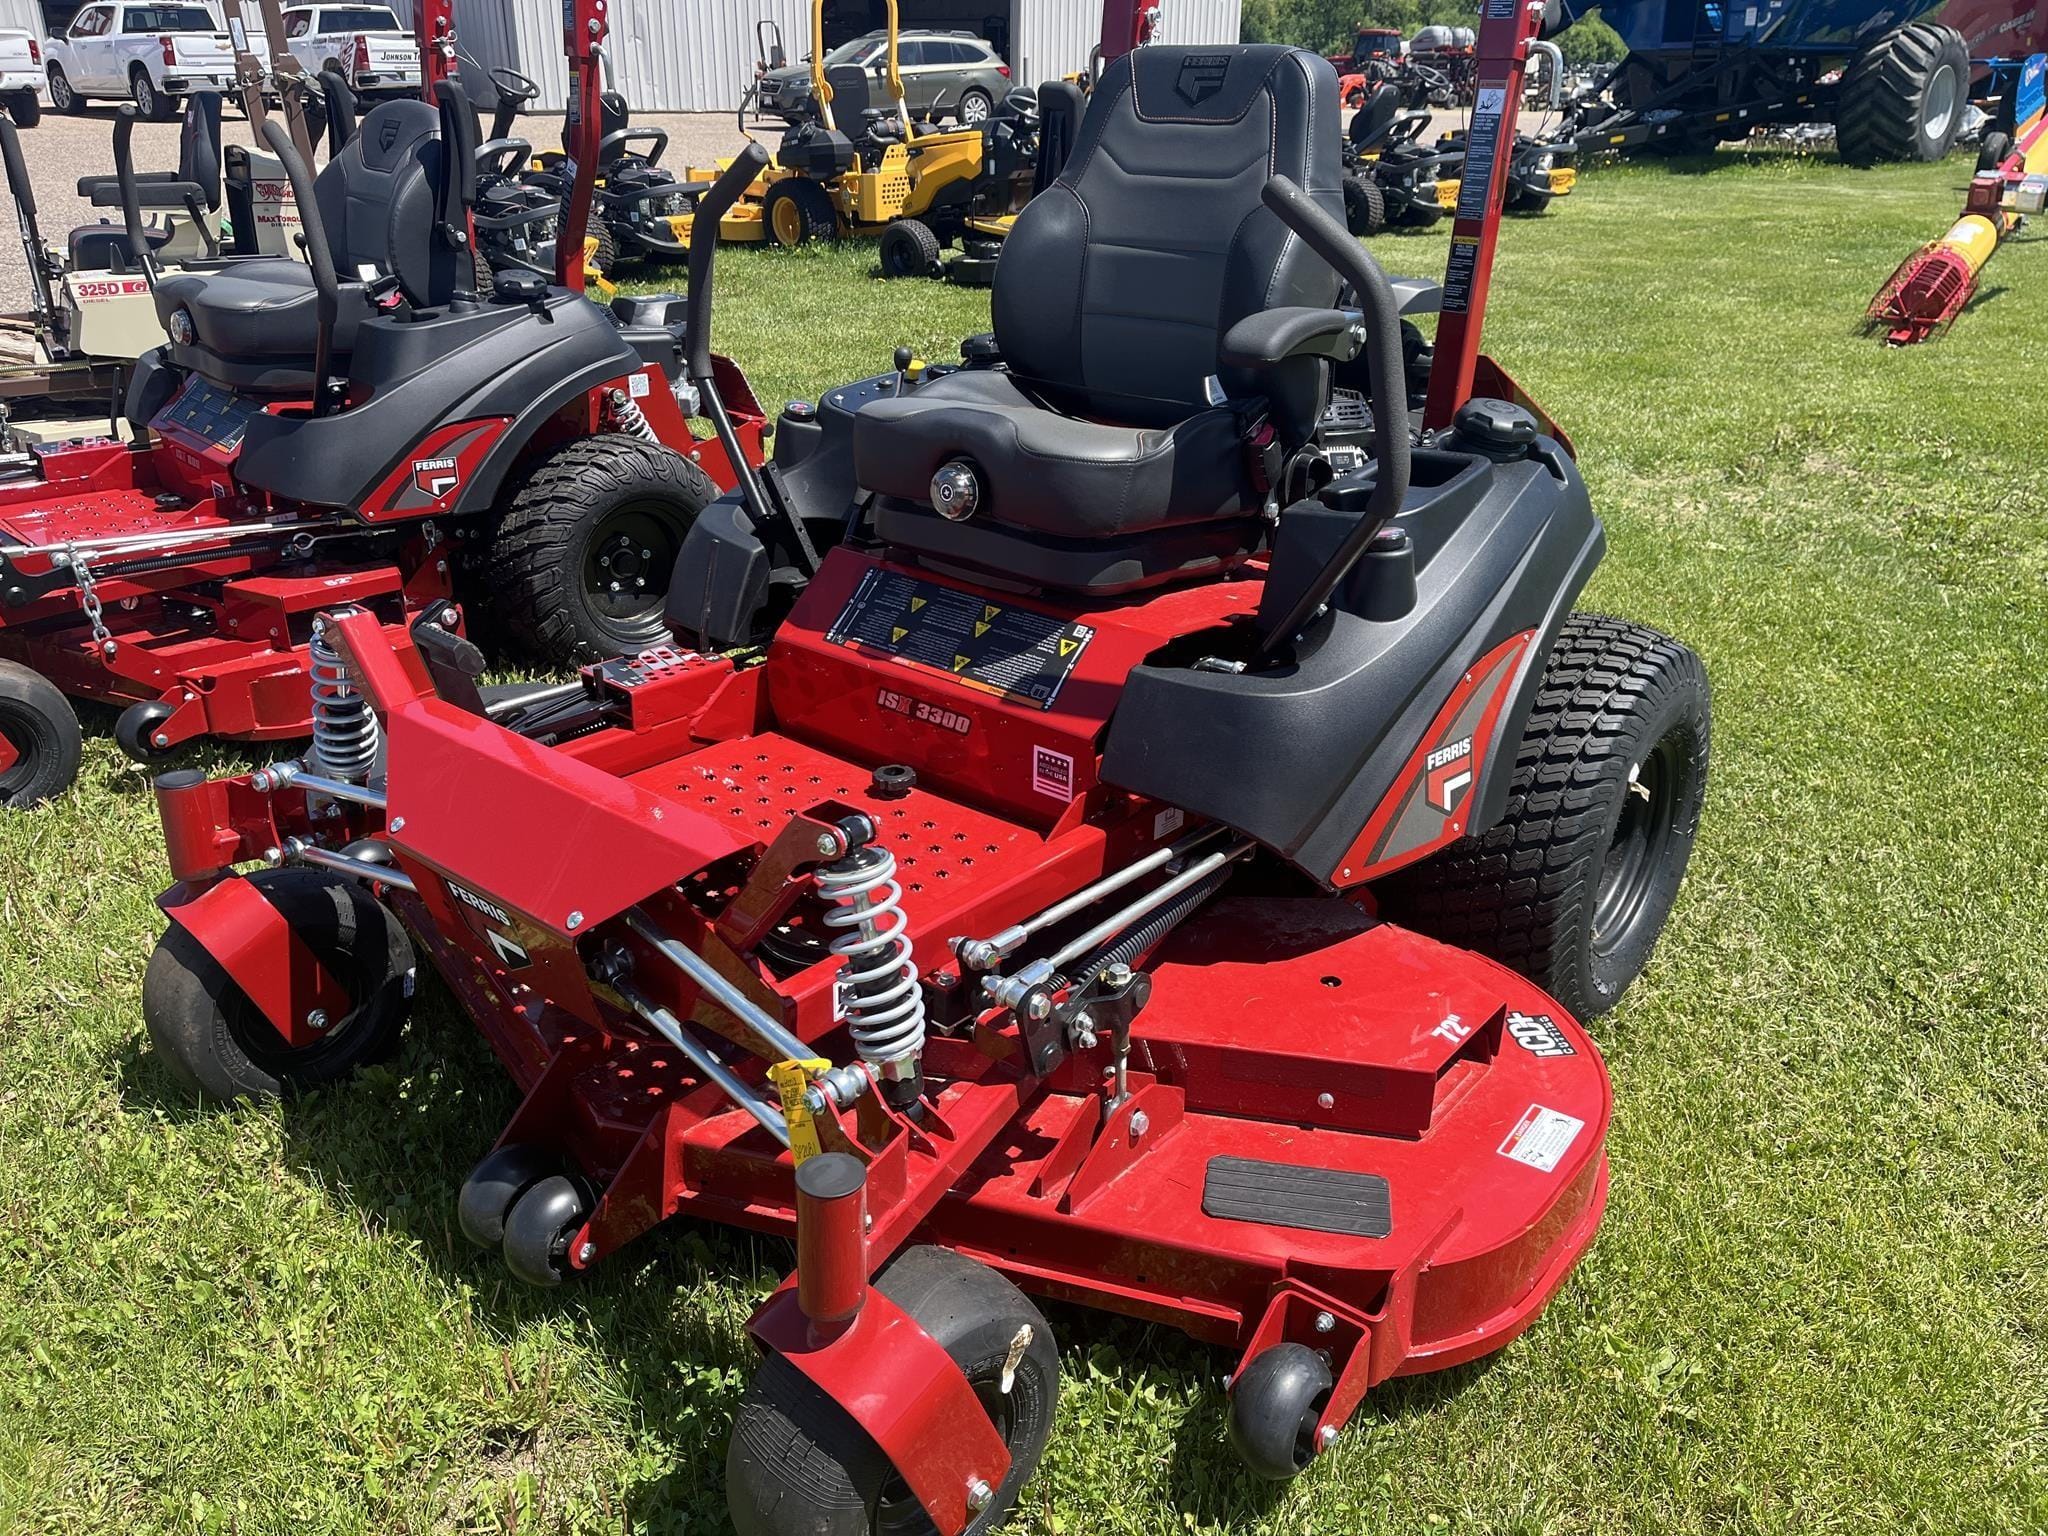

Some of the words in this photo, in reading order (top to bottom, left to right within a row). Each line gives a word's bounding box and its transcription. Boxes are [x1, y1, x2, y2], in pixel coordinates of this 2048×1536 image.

[78, 282, 120, 297] 325D
[415, 459, 455, 471] FERRIS
[878, 689, 913, 715] ISX
[915, 702, 971, 734] 3300
[1427, 737, 1472, 771] FERRIS
[1054, 772, 1068, 783] USA
[447, 880, 512, 927] FERRIS
[1431, 1013, 1472, 1044] 72"
[1539, 1015, 1575, 1055] CUTTING
